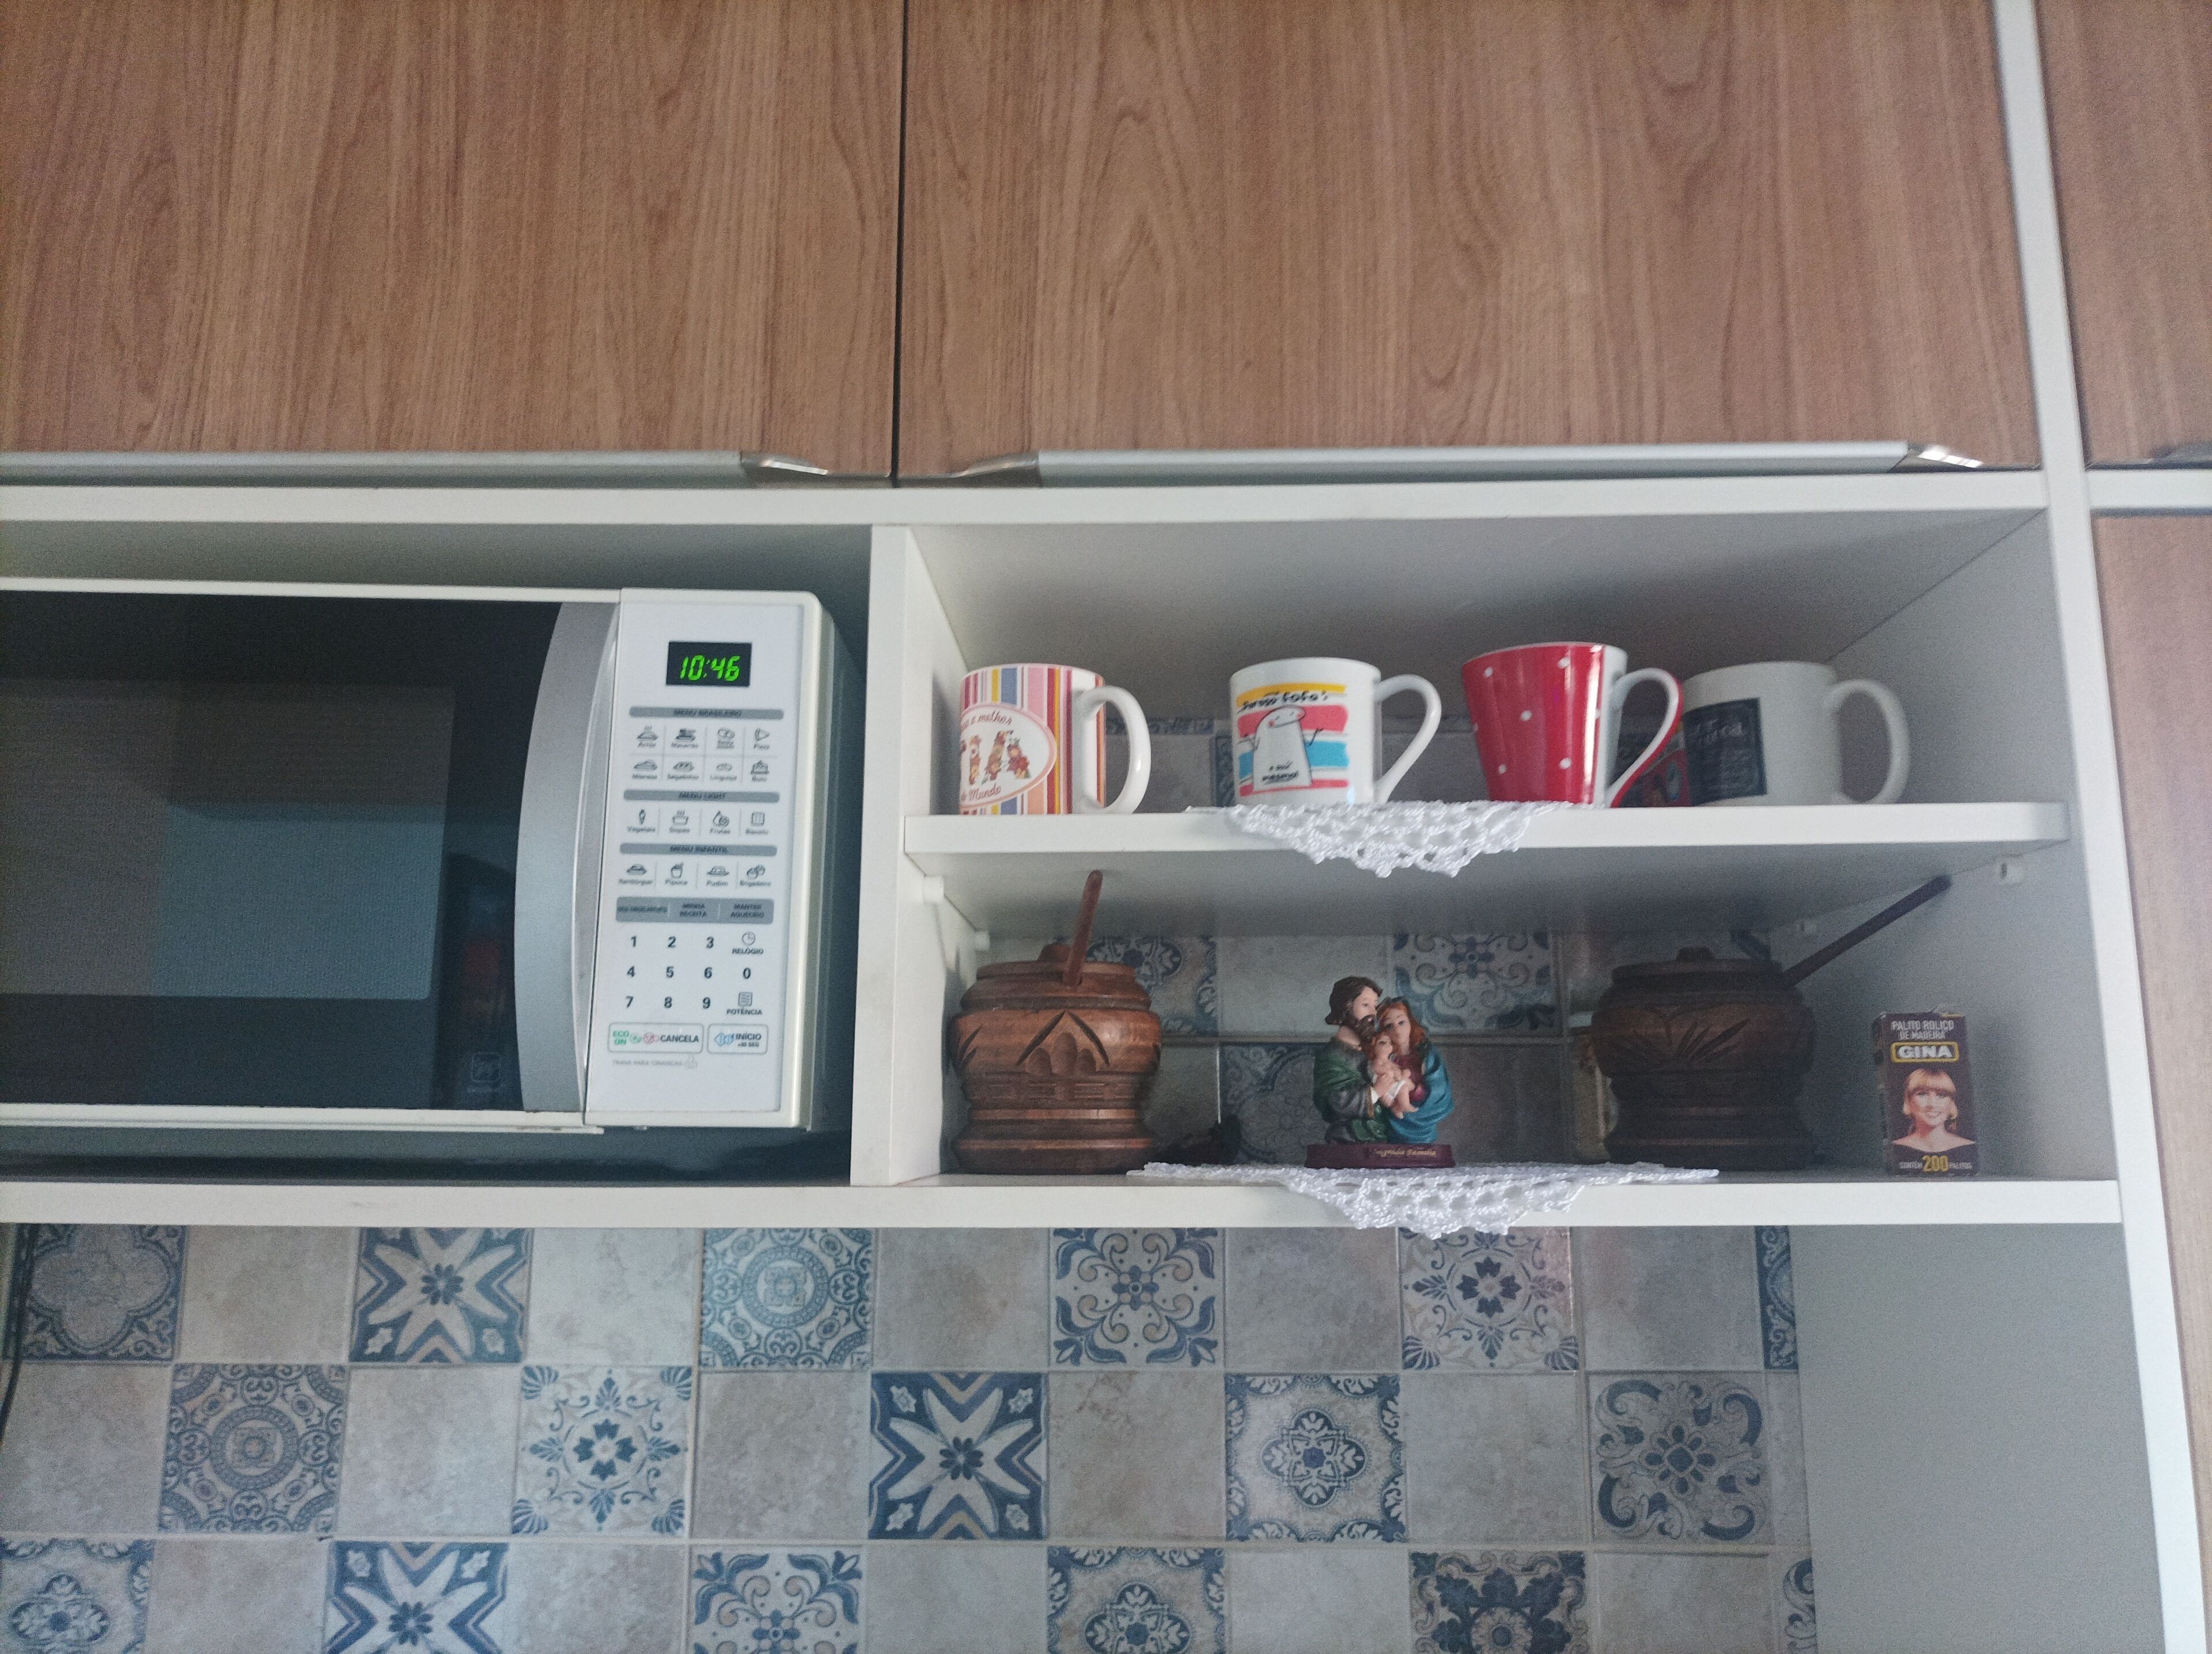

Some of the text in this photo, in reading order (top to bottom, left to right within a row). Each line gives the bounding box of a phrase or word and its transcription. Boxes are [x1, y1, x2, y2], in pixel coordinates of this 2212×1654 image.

[680, 655, 741, 681] 10:46
[977, 710, 1013, 725] melhor
[969, 783, 1001, 801] Mundo
[631, 935, 637, 947] 1
[668, 936, 676, 948] 2
[706, 936, 714, 949] 3
[627, 965, 635, 977] 4
[666, 966, 674, 978] 5
[704, 966, 713, 979] 6
[743, 967, 751, 979] 0
[626, 996, 634, 1008] 7
[664, 996, 672, 1008] 8
[702, 997, 711, 1009] 9
[1891, 1020, 1921, 1031] PALITO
[736, 1031, 762, 1040] INÍCIO
[1899, 1030, 1946, 1040] DE MADEIRA
[1897, 1045, 1953, 1059] GINA
[1922, 1155, 1949, 1172] 200
